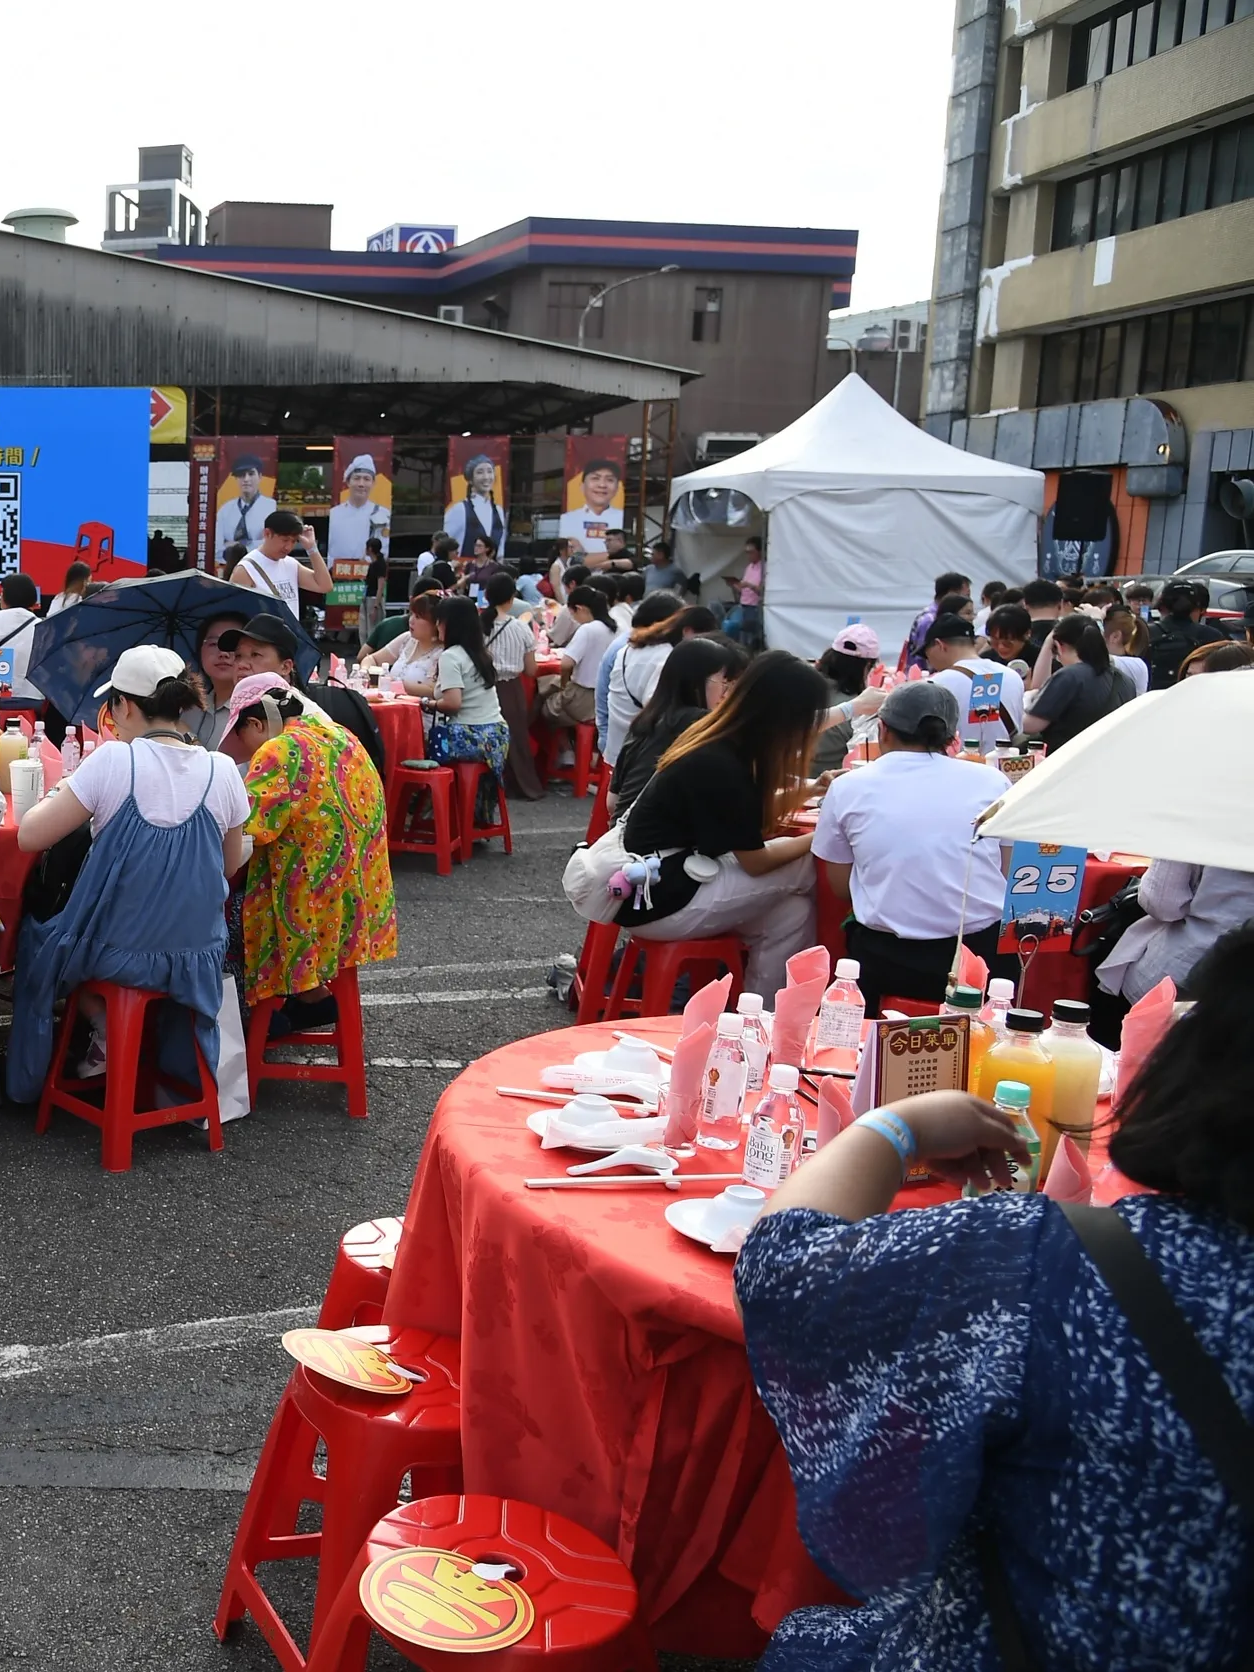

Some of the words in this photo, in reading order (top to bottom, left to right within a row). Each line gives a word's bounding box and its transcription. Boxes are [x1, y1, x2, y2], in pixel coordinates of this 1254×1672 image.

[972, 683, 1000, 698] 20
[1010, 864, 1079, 895] 25
[890, 1032, 956, 1052] 今日菜單
[749, 1135, 775, 1153] Babu
